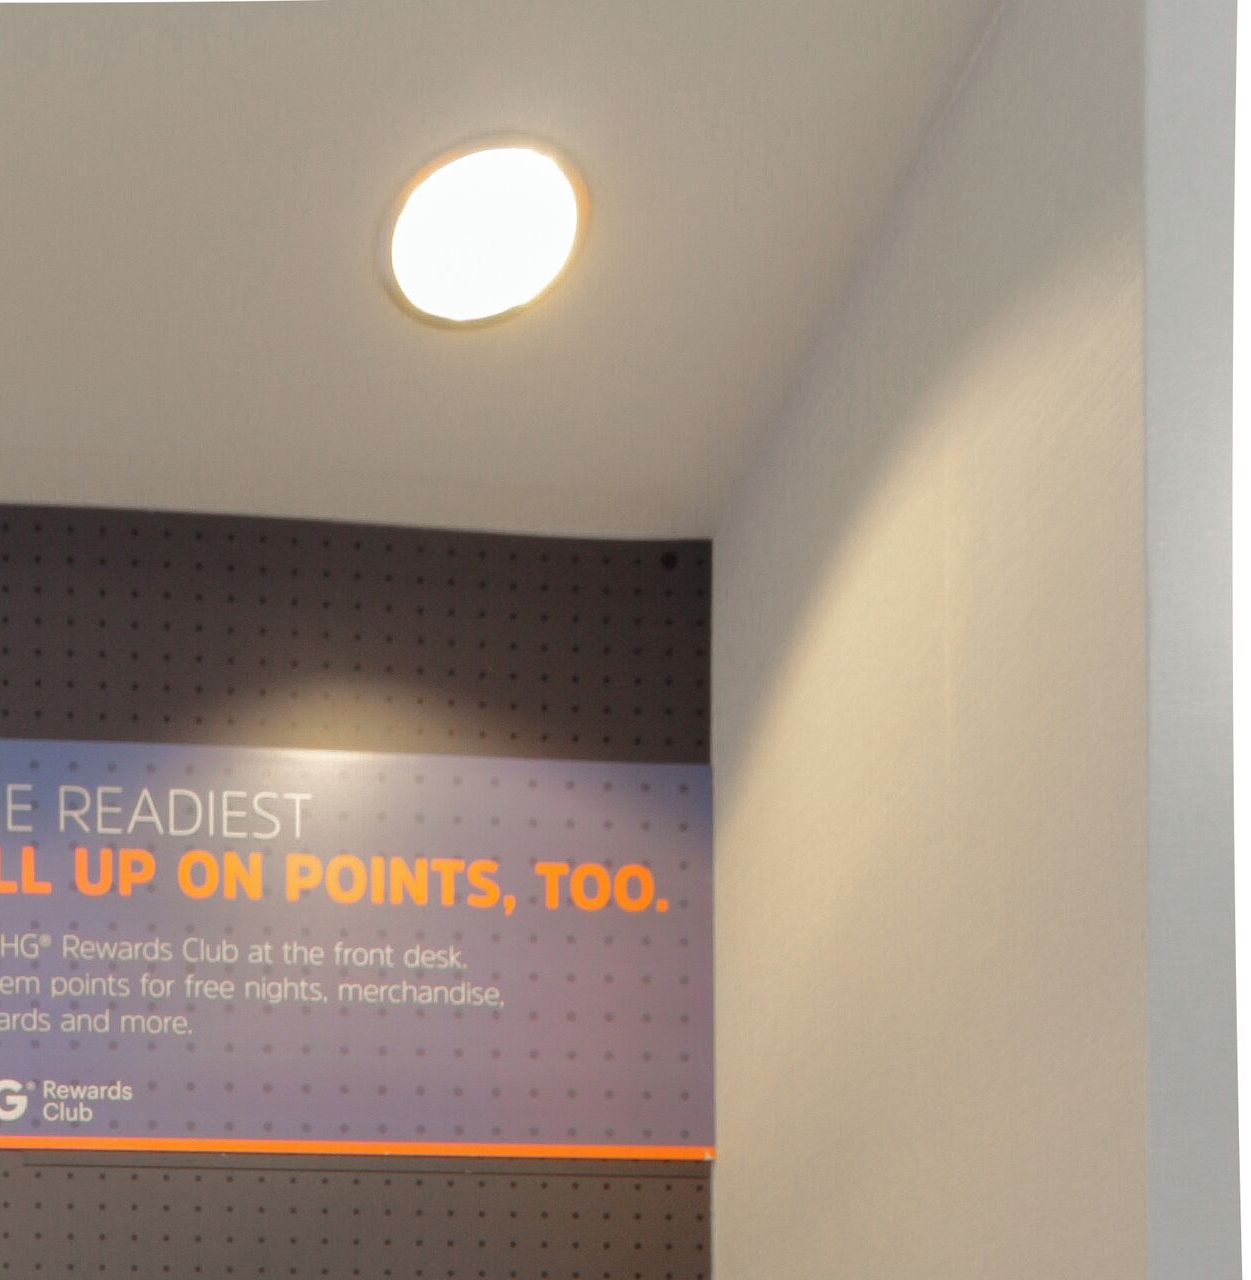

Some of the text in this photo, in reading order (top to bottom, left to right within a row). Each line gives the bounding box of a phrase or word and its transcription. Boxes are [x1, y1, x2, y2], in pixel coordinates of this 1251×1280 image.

[59, 785, 312, 840] READIEST
[74, 848, 156, 896] UP
[177, 850, 263, 899] ON
[285, 853, 516, 917] POINTS,
[535, 861, 669, 912] TOO.
[62, 934, 173, 962] Rewards
[182, 937, 239, 964] Club
[248, 942, 273, 965] at
[282, 941, 325, 966] the
[333, 941, 395, 968] front
[403, 944, 468, 970] desk.
[51, 973, 130, 998] points
[140, 973, 175, 997] for
[184, 974, 235, 999] free
[60, 1009, 110, 1033] and
[120, 1013, 193, 1035] more.
[43, 1080, 133, 1101] Rewards
[43, 1102, 94, 1122] Club
